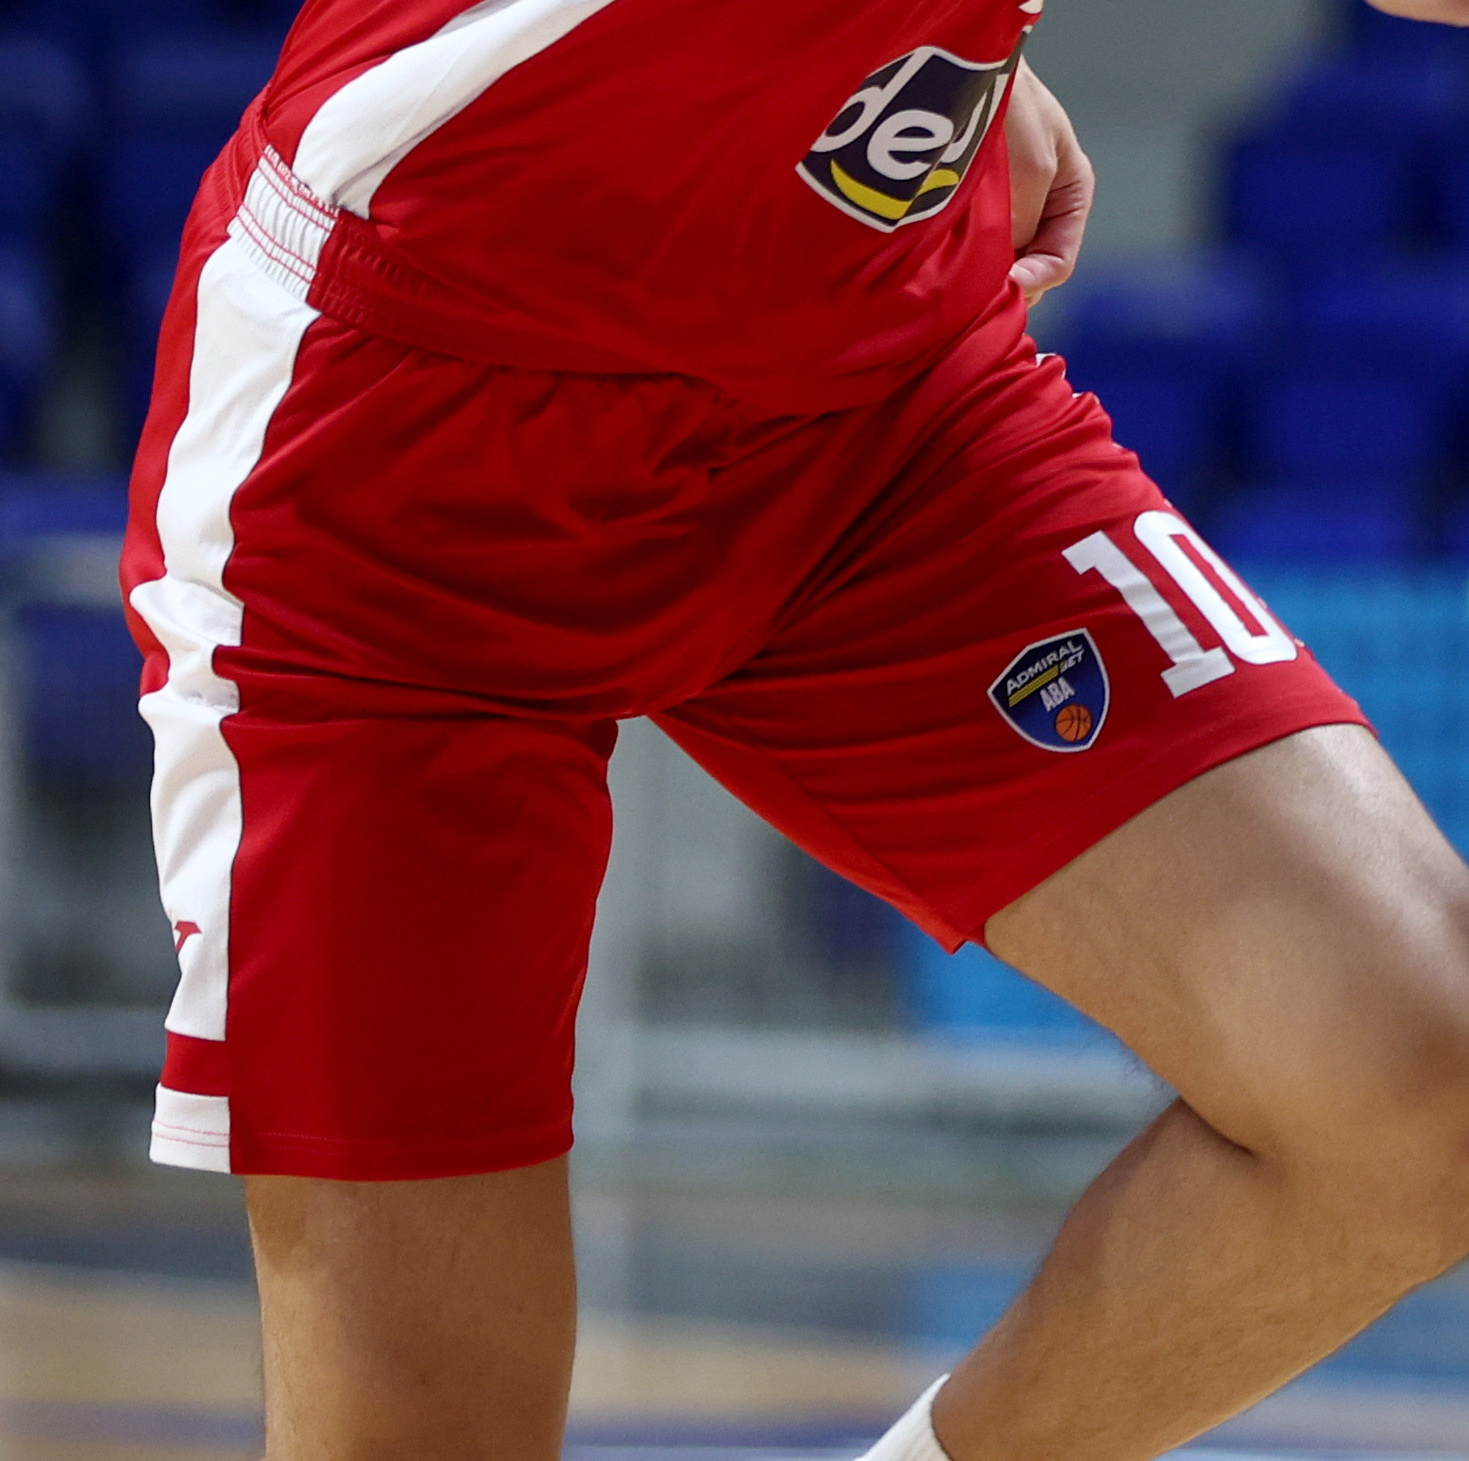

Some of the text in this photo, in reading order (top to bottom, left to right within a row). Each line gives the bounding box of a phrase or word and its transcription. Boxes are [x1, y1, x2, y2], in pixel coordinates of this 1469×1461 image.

[1061, 510, 1298, 699] 10
[1006, 639, 1083, 696] ADMIRAL
[1039, 676, 1075, 712] ABA
